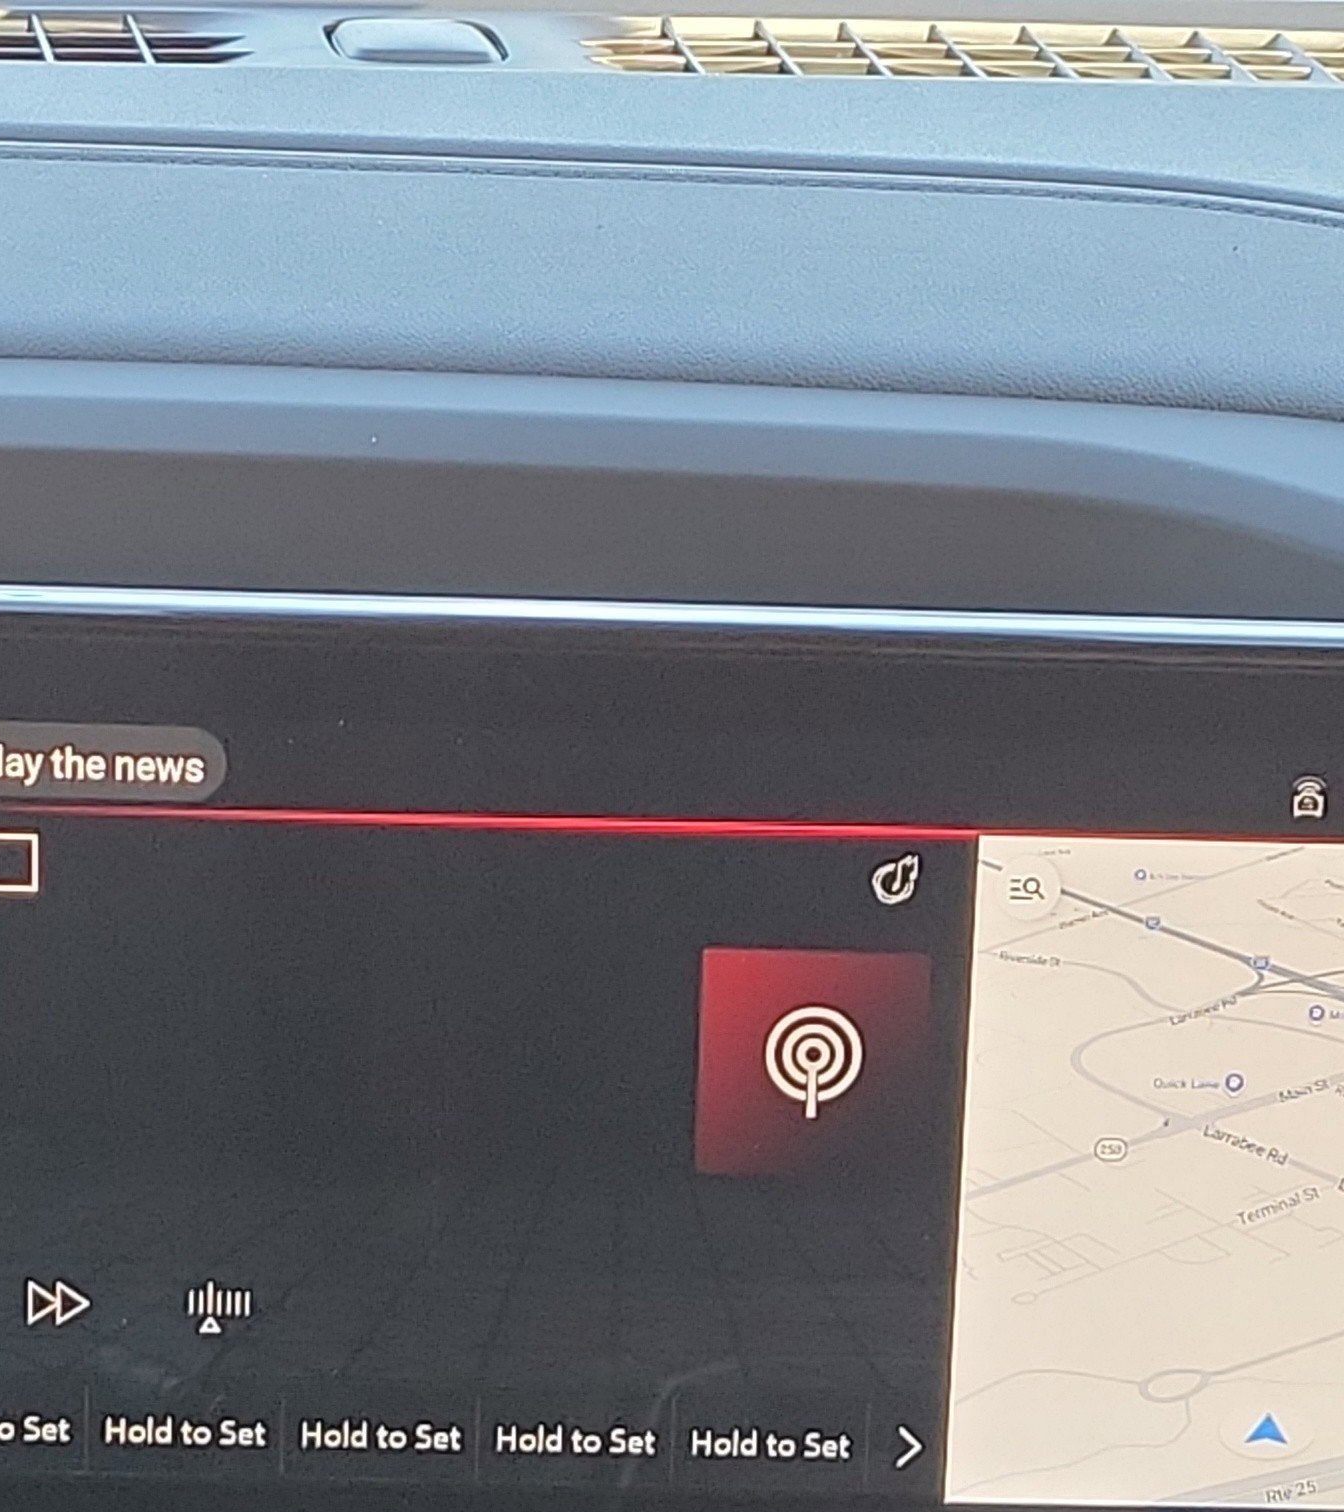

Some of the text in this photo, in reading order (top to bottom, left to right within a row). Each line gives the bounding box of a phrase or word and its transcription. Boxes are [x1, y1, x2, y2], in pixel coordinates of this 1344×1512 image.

[50, 745, 106, 781] the
[113, 754, 205, 784] news
[1202, 1124, 1290, 1166] Larrabee Rd
[1236, 1186, 1321, 1226] Terminal St
[22, 1415, 72, 1442] Set
[105, 1415, 267, 1447] Hold to Set
[301, 1420, 462, 1452] Hold to Set
[496, 1424, 657, 1456] Hold to Set
[691, 1428, 852, 1460] Hold to Set
[1296, 1480, 1318, 1498] 25
